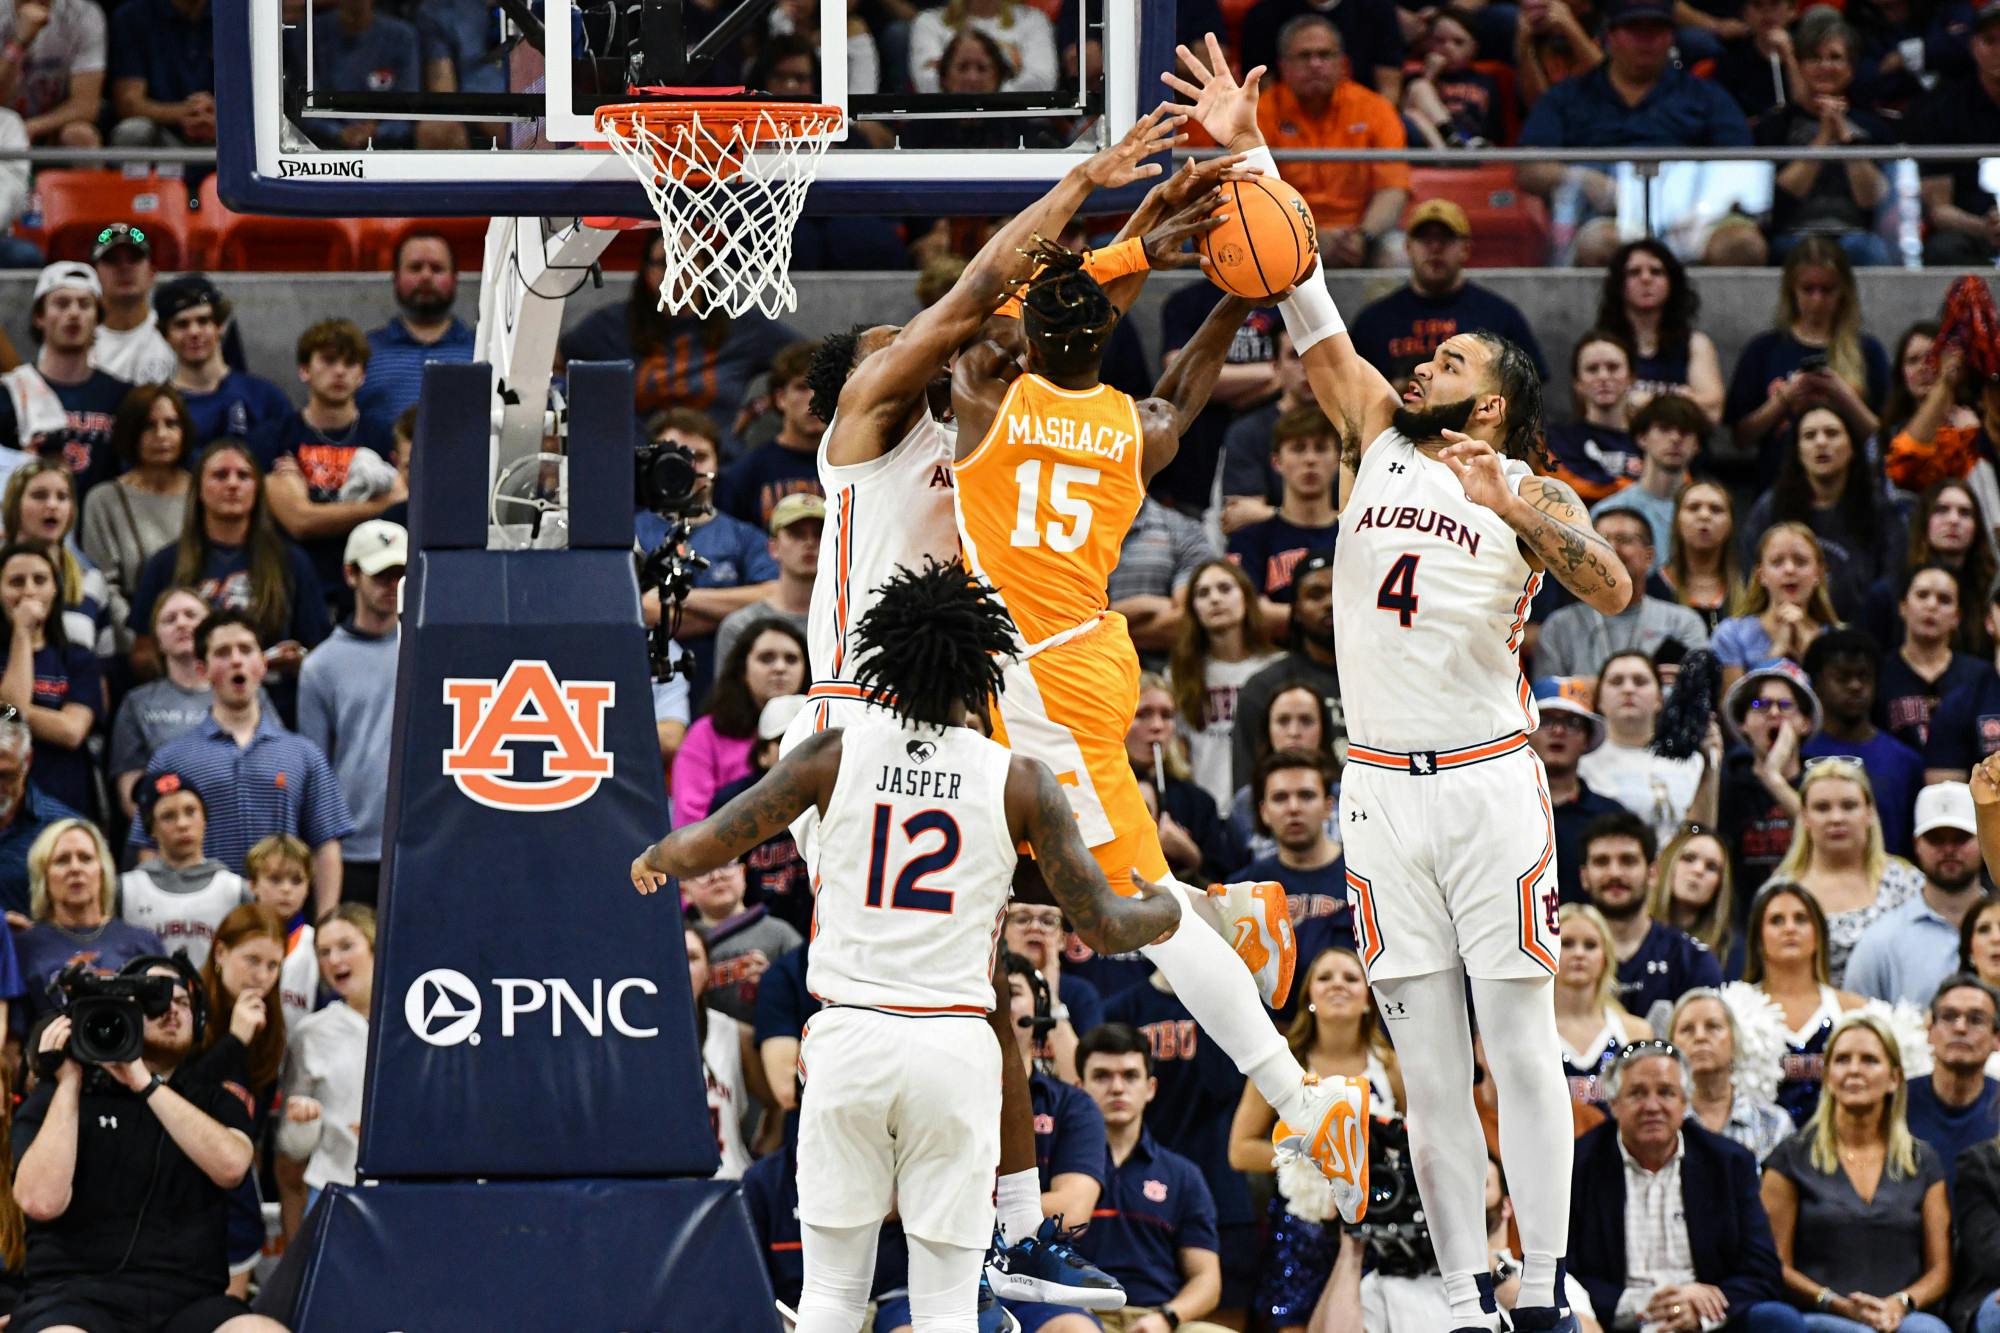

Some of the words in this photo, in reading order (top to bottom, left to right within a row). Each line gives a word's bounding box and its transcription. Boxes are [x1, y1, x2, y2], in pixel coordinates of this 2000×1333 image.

[278, 160, 363, 178] SPALDING
[1289, 198, 1315, 254] NCAA
[1007, 414, 1133, 463] MASHACK
[1010, 459, 1101, 552] 15
[1354, 506, 1481, 558] AUBURN
[1377, 552, 1421, 628] 4
[876, 765, 962, 799] JASPER
[865, 803, 963, 914] 12
[491, 977, 659, 1038] PNC
